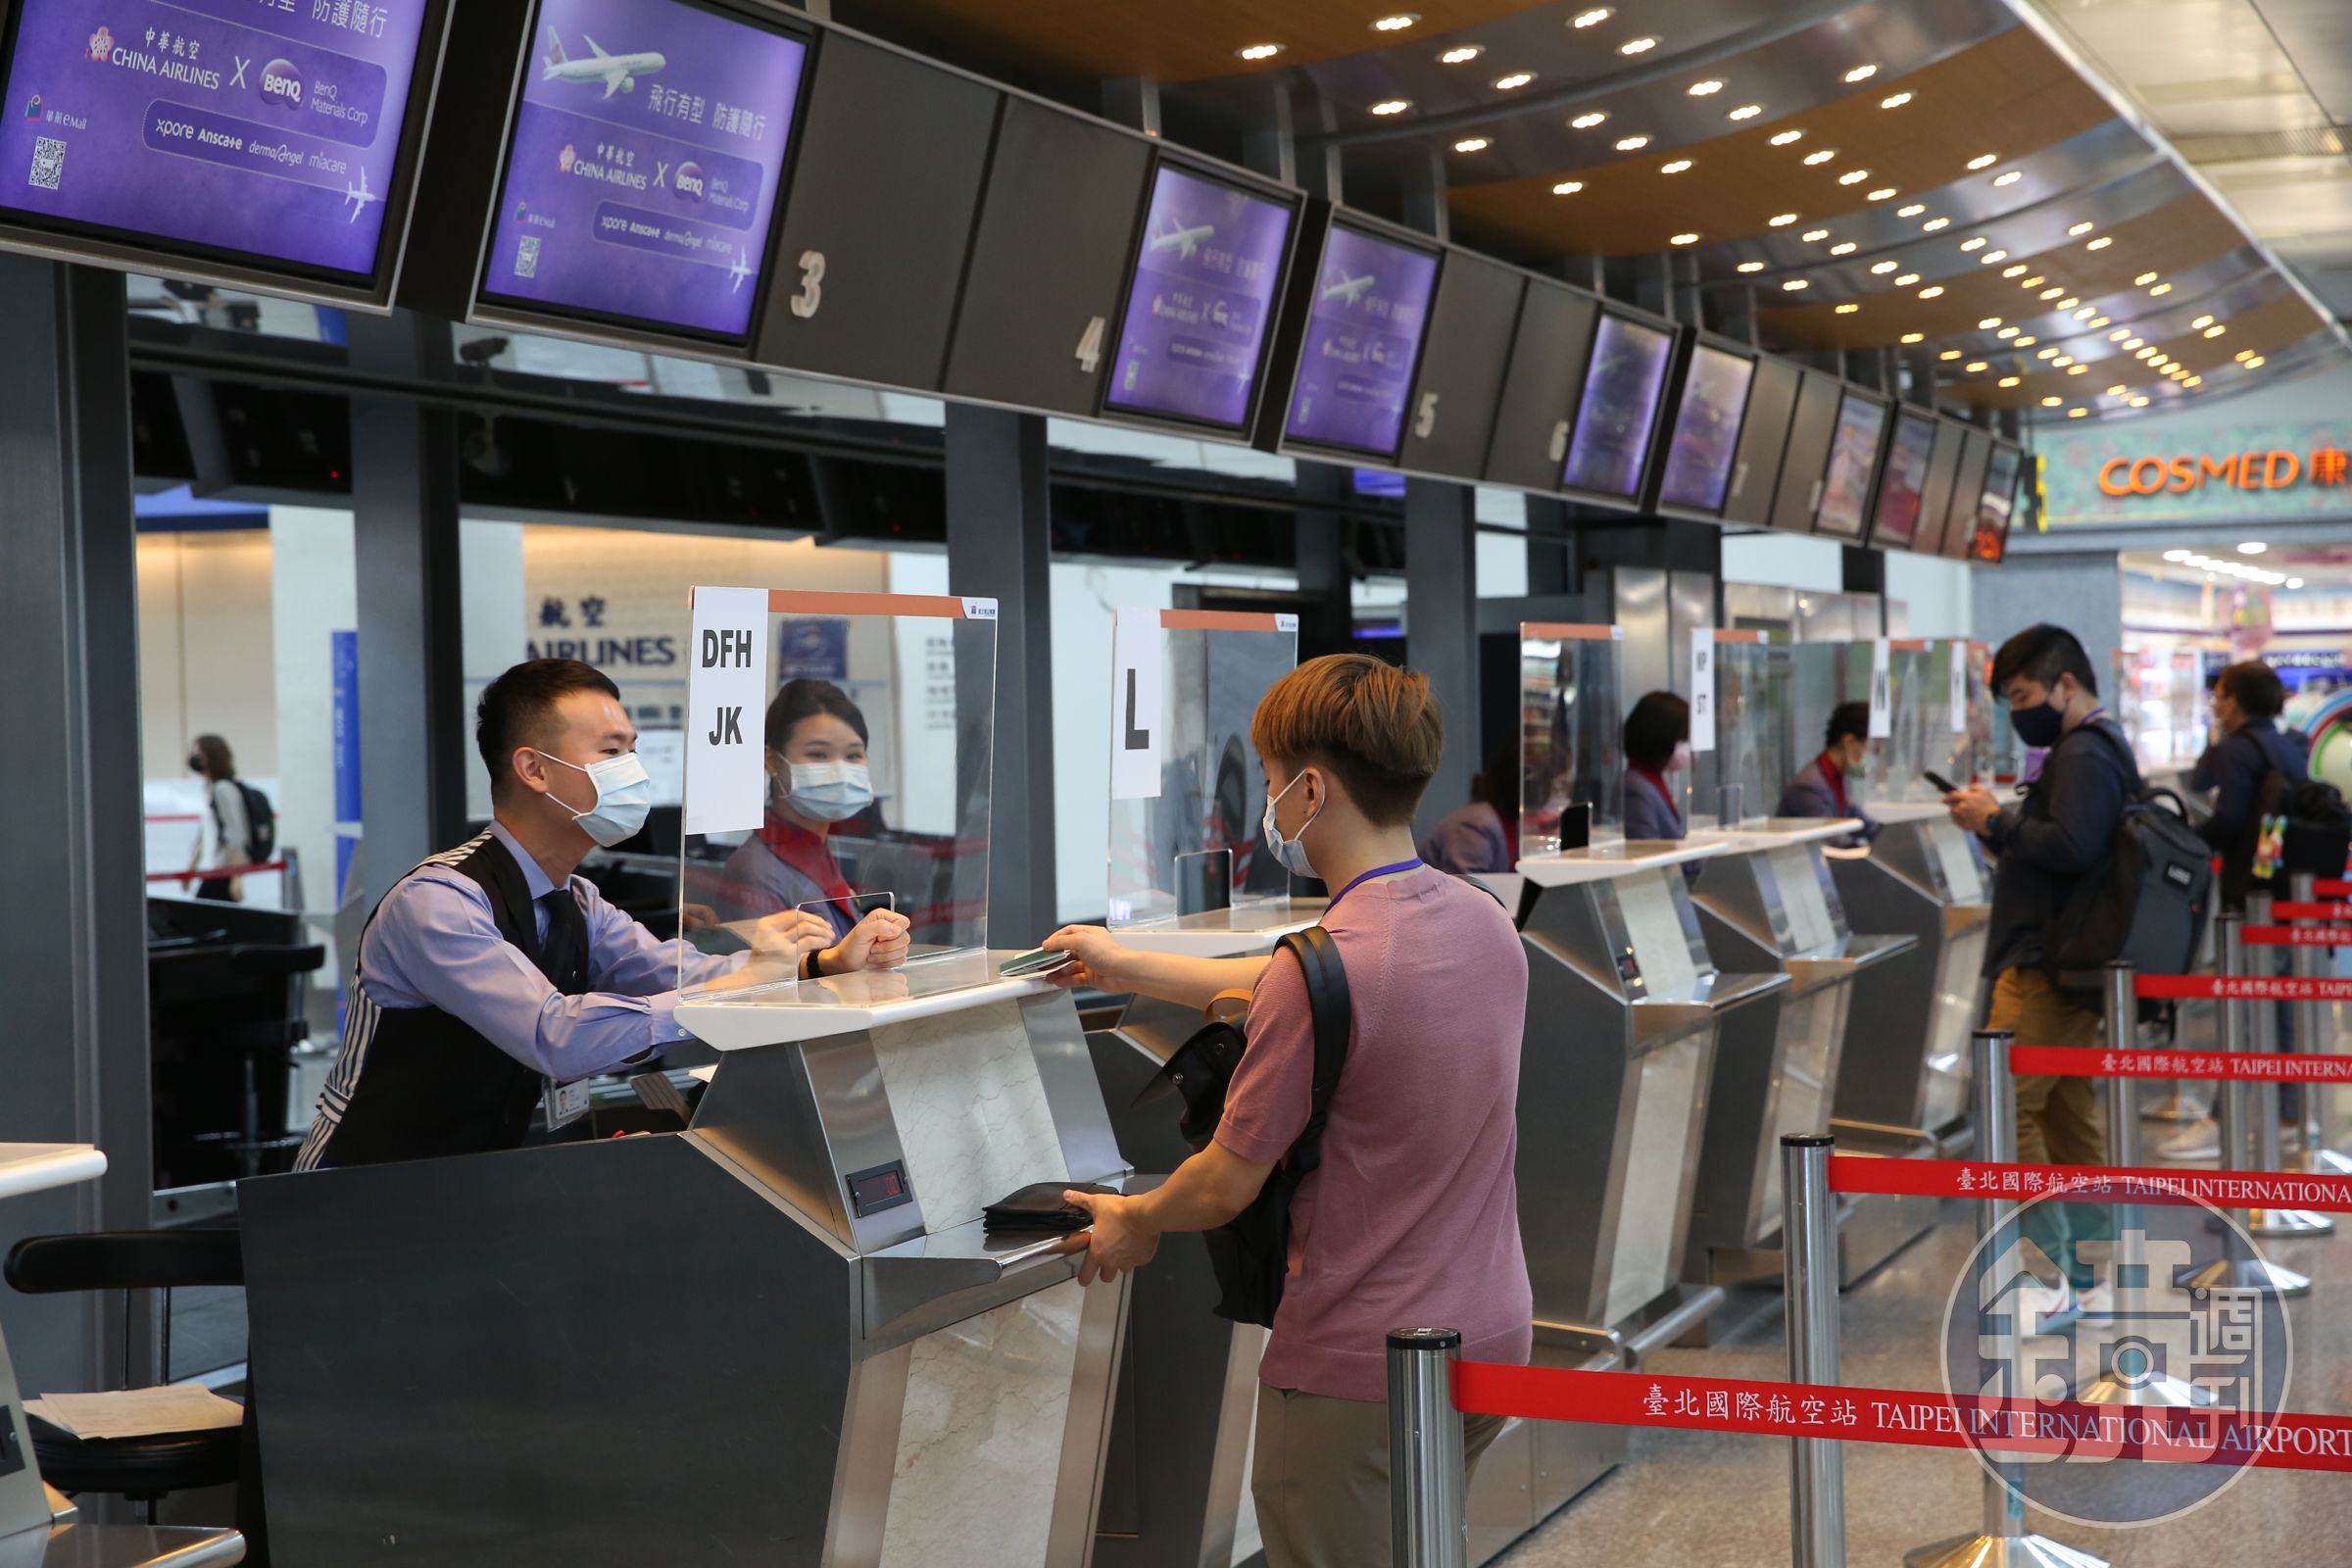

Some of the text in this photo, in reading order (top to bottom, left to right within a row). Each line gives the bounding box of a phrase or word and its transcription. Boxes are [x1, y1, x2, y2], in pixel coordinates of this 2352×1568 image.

[145, 26, 200, 60] 中華航空
[112, 47, 157, 74] CHINA
[159, 60, 220, 90] AIRLINES
[264, 74, 301, 102] BenQ
[314, 80, 337, 101] BenQ
[311, 97, 368, 126] Materials Corp
[156, 119, 194, 140] xpore
[309, 151, 347, 174] miacare
[573, 160, 605, 179] CHINA
[607, 169, 647, 190] AIRLINES
[790, 251, 826, 318] 3
[1075, 317, 1105, 373] 4
[1415, 393, 1439, 438] 5
[2098, 450, 2300, 496] COSMED
[526, 637, 676, 666] AIRLINES
[702, 629, 753, 668] DFH
[709, 706, 743, 745] JK
[1125, 668, 1150, 750] L
[2101, 1054, 2224, 1074] 臺北國際航空站
[2230, 1057, 2281, 1075] TAIPEI
[1956, 1168, 2352, 1203] 臺北國際航空站 TAIPEI INTERNATIONA
[1642, 1383, 2352, 1456] 臺北國際航空站 TAIPEI INTERNATIONAL AIRPORT
